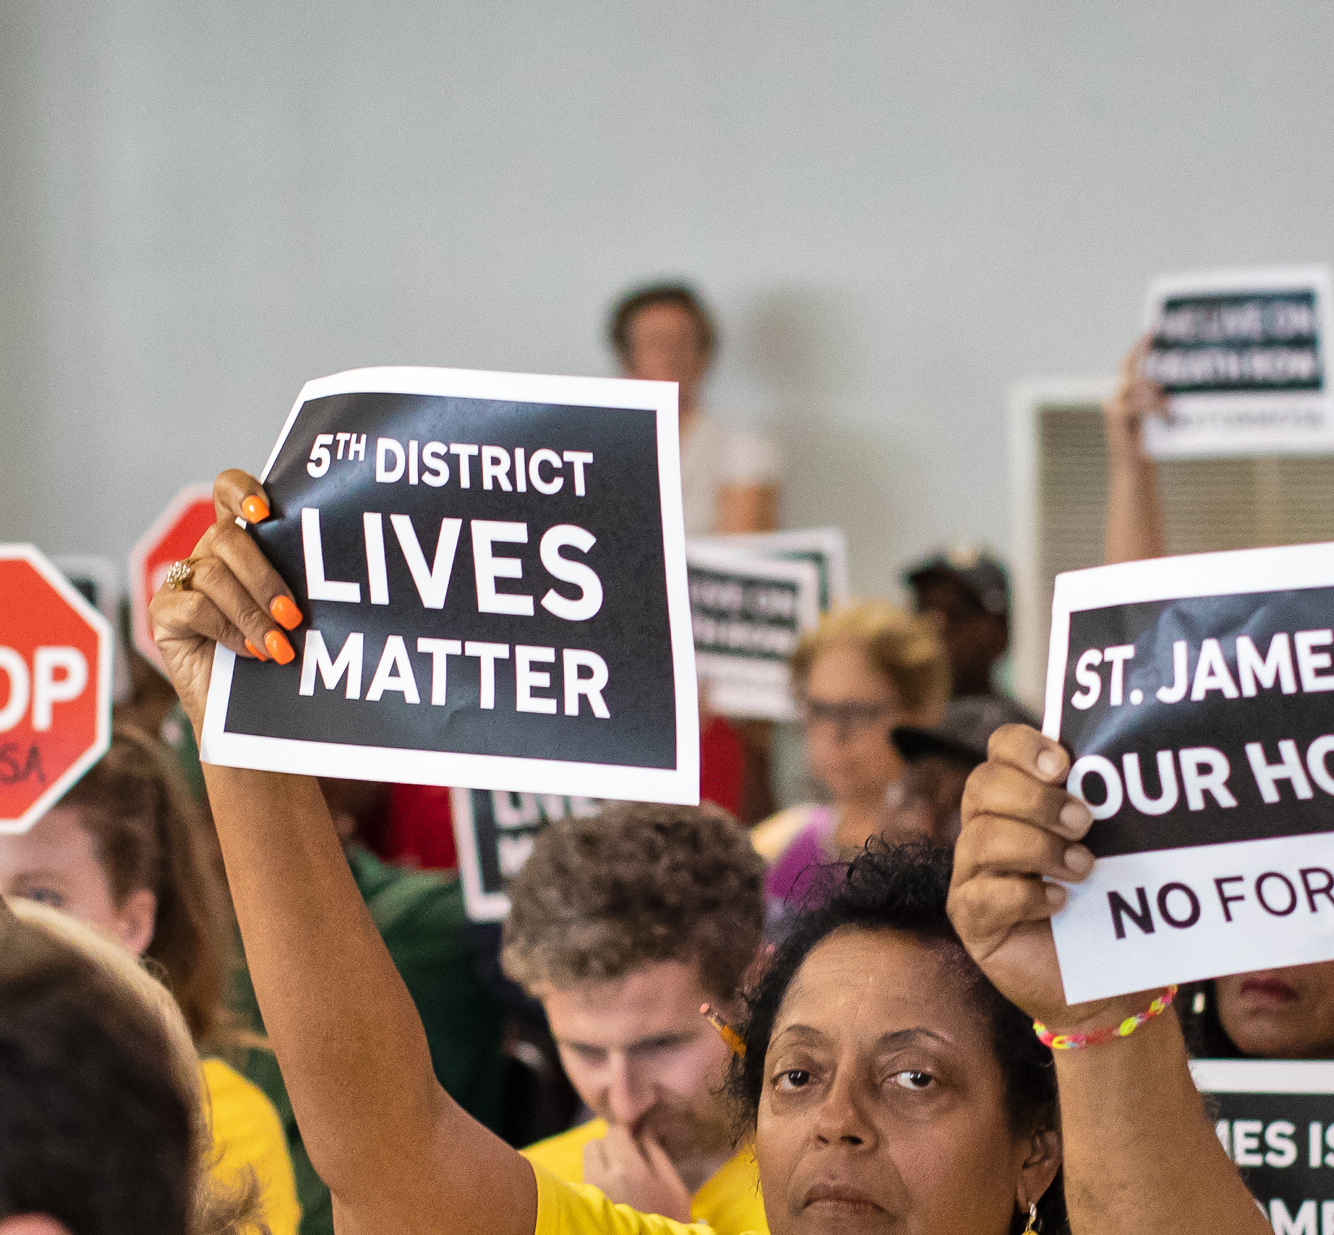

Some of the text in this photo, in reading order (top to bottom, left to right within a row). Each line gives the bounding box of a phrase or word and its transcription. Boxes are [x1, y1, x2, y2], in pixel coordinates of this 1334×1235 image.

[306, 432, 594, 497] 5TH DISTRICT
[301, 507, 604, 622] LIVES
[299, 629, 611, 719] MATTER
[1070, 643, 1143, 710] ST.
[1067, 746, 1237, 821] OUR
[1107, 882, 1201, 940] NO
